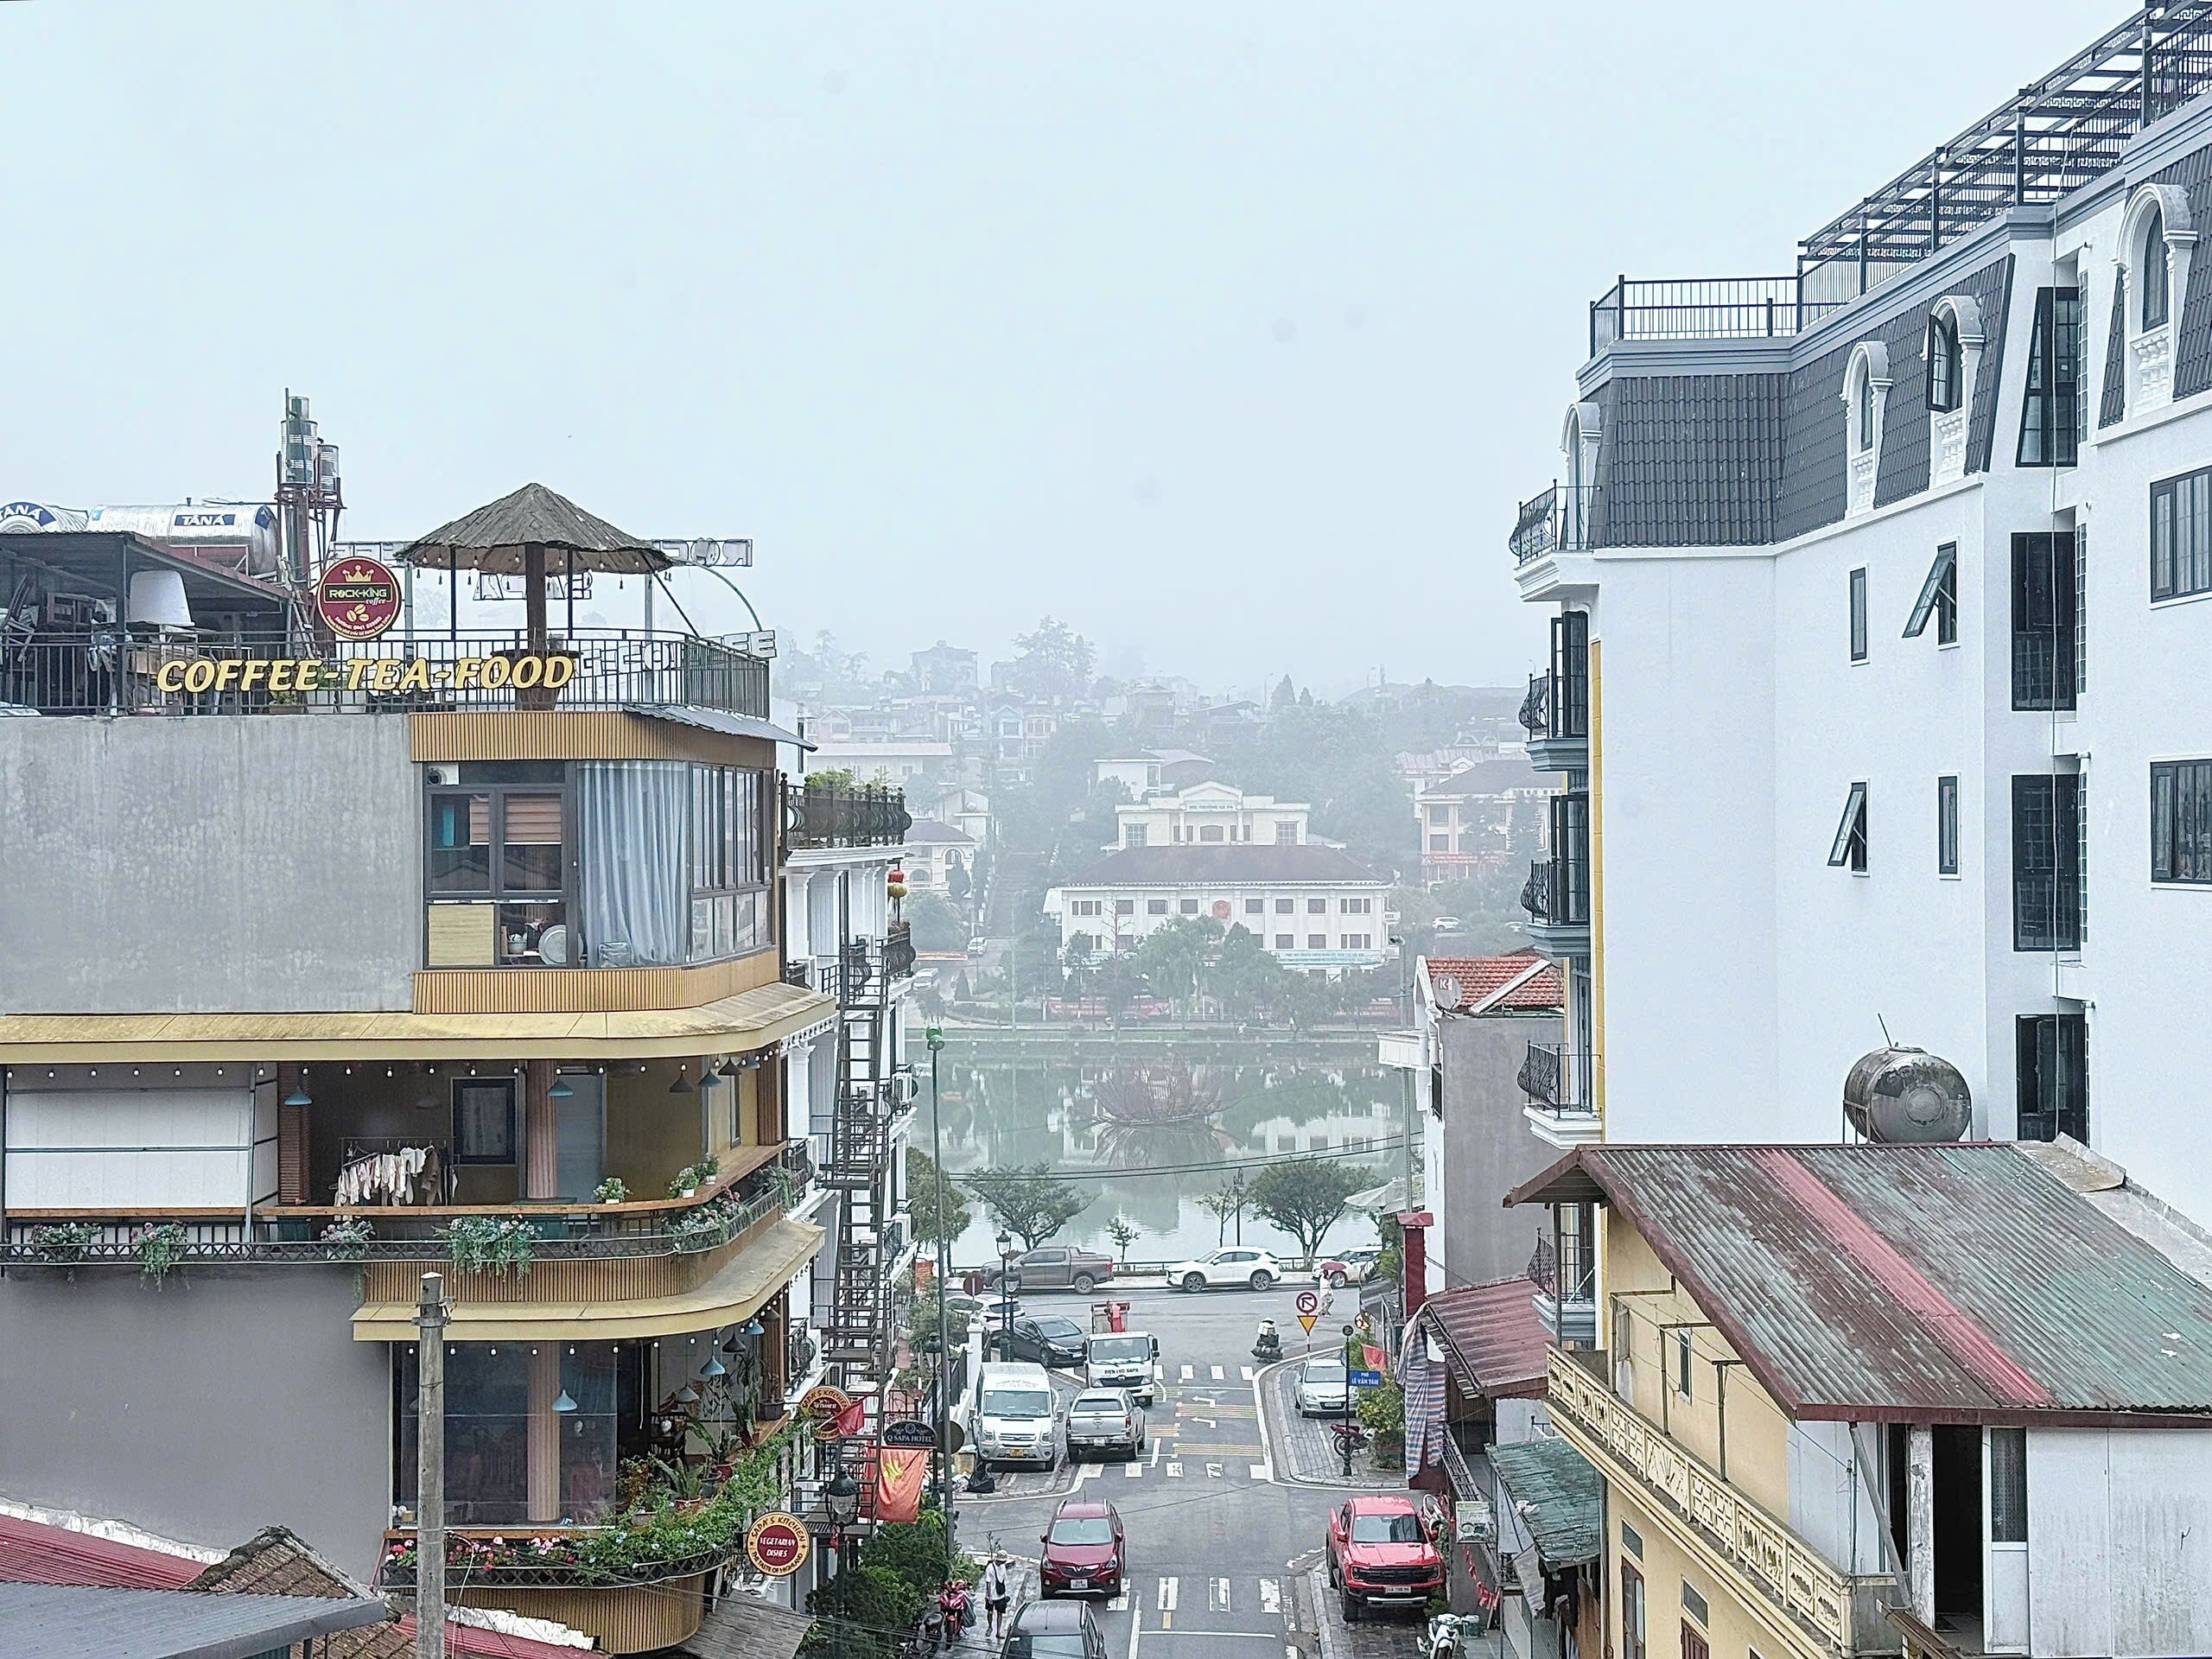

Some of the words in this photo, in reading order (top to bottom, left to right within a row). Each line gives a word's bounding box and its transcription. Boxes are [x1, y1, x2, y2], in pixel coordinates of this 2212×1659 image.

[329, 588, 387, 598] ROCK-KING
[365, 597, 386, 606] coffee
[751, 1516, 775, 1539] SAPA'S
[778, 1516, 806, 1542] KITCHEN
[760, 1537, 796, 1547] VEGETARIAN
[766, 1548, 789, 1558] DISHES
[758, 1560, 772, 1572] TASTE
[779, 1553, 804, 1573] HIGHLAND
